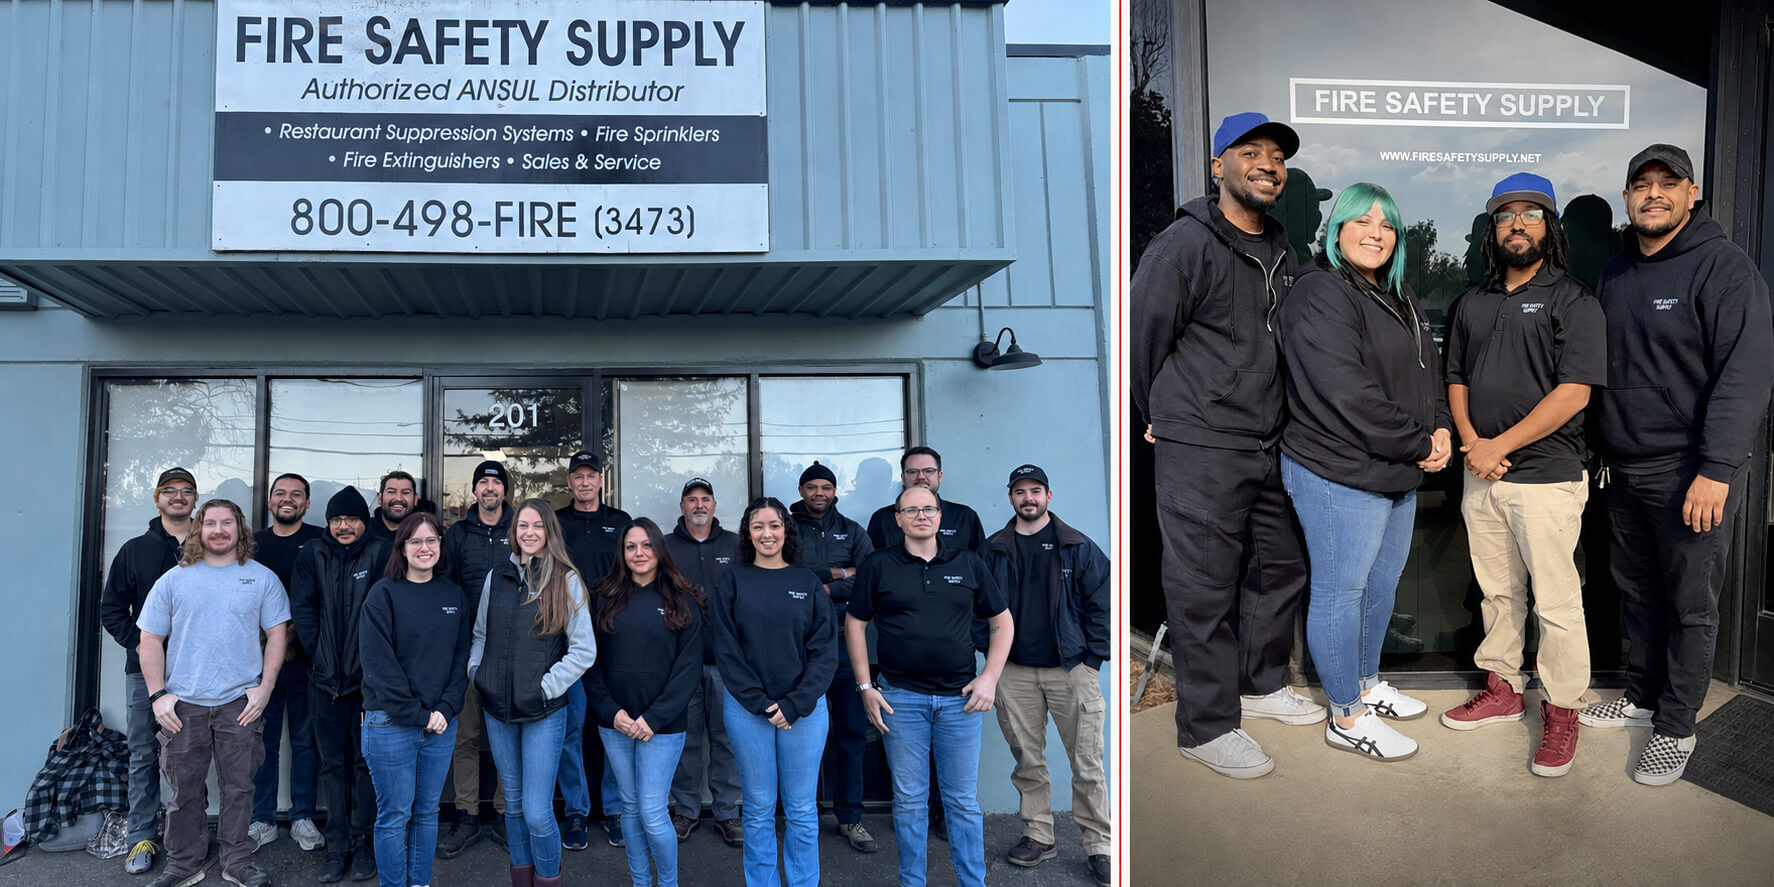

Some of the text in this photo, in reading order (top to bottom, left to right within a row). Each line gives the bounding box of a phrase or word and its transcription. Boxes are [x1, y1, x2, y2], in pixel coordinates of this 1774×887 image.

[237, 16, 745, 66] FIRE SAFETY SUPPLY
[301, 78, 684, 101] Authorized ANSUL Distributor
[1316, 90, 1605, 116] FIRE SAFETY SUPPLY
[280, 124, 719, 145] Restaurant Suppression Systems Fire Sprinklers
[344, 152, 661, 172] Fire Extinguishers Sales & Service
[1380, 152, 1541, 163] WWW.FIRESAFETYSUPPLY.NET
[291, 198, 694, 239] 800-498-FIRE (3473)
[487, 402, 537, 430] 201
